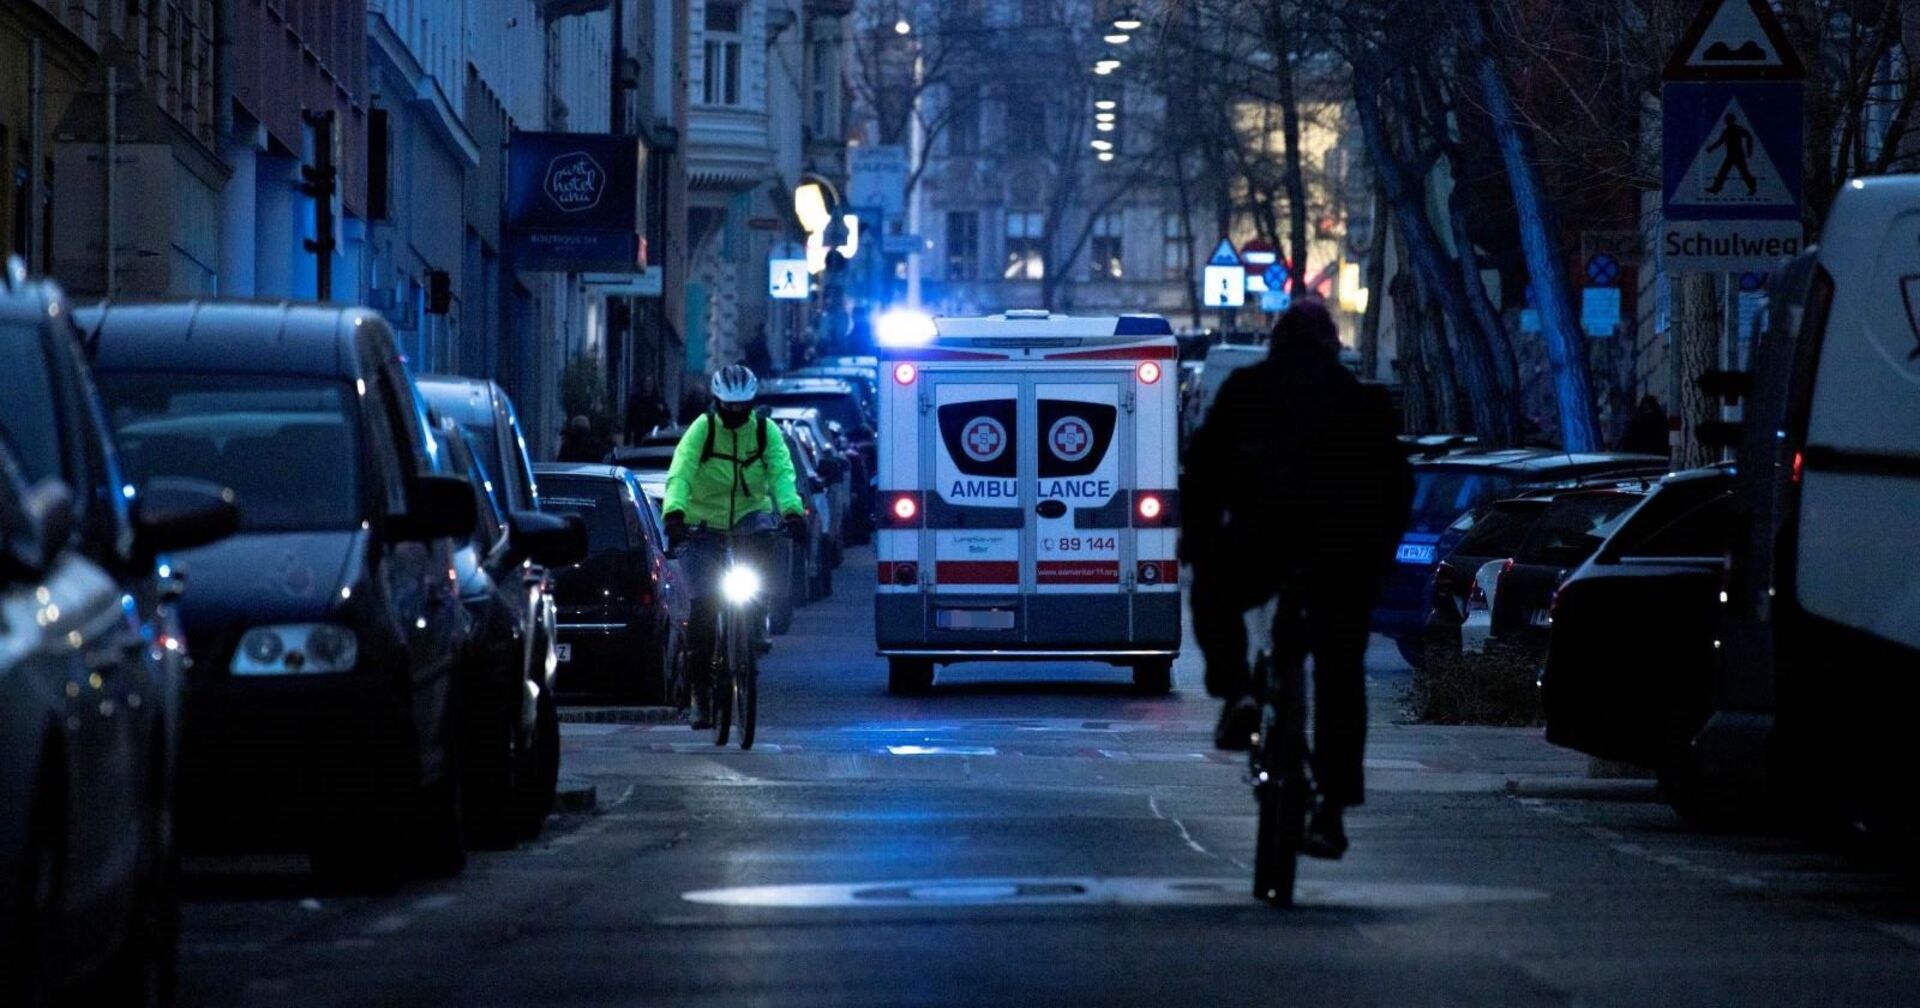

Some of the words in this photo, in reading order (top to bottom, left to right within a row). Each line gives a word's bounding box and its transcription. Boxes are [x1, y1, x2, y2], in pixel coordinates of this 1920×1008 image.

[553, 169, 595, 192] hotel
[1666, 232, 1798, 258] Schulweg
[1059, 538, 1080, 551] 89
[1086, 537, 1115, 551] 144
